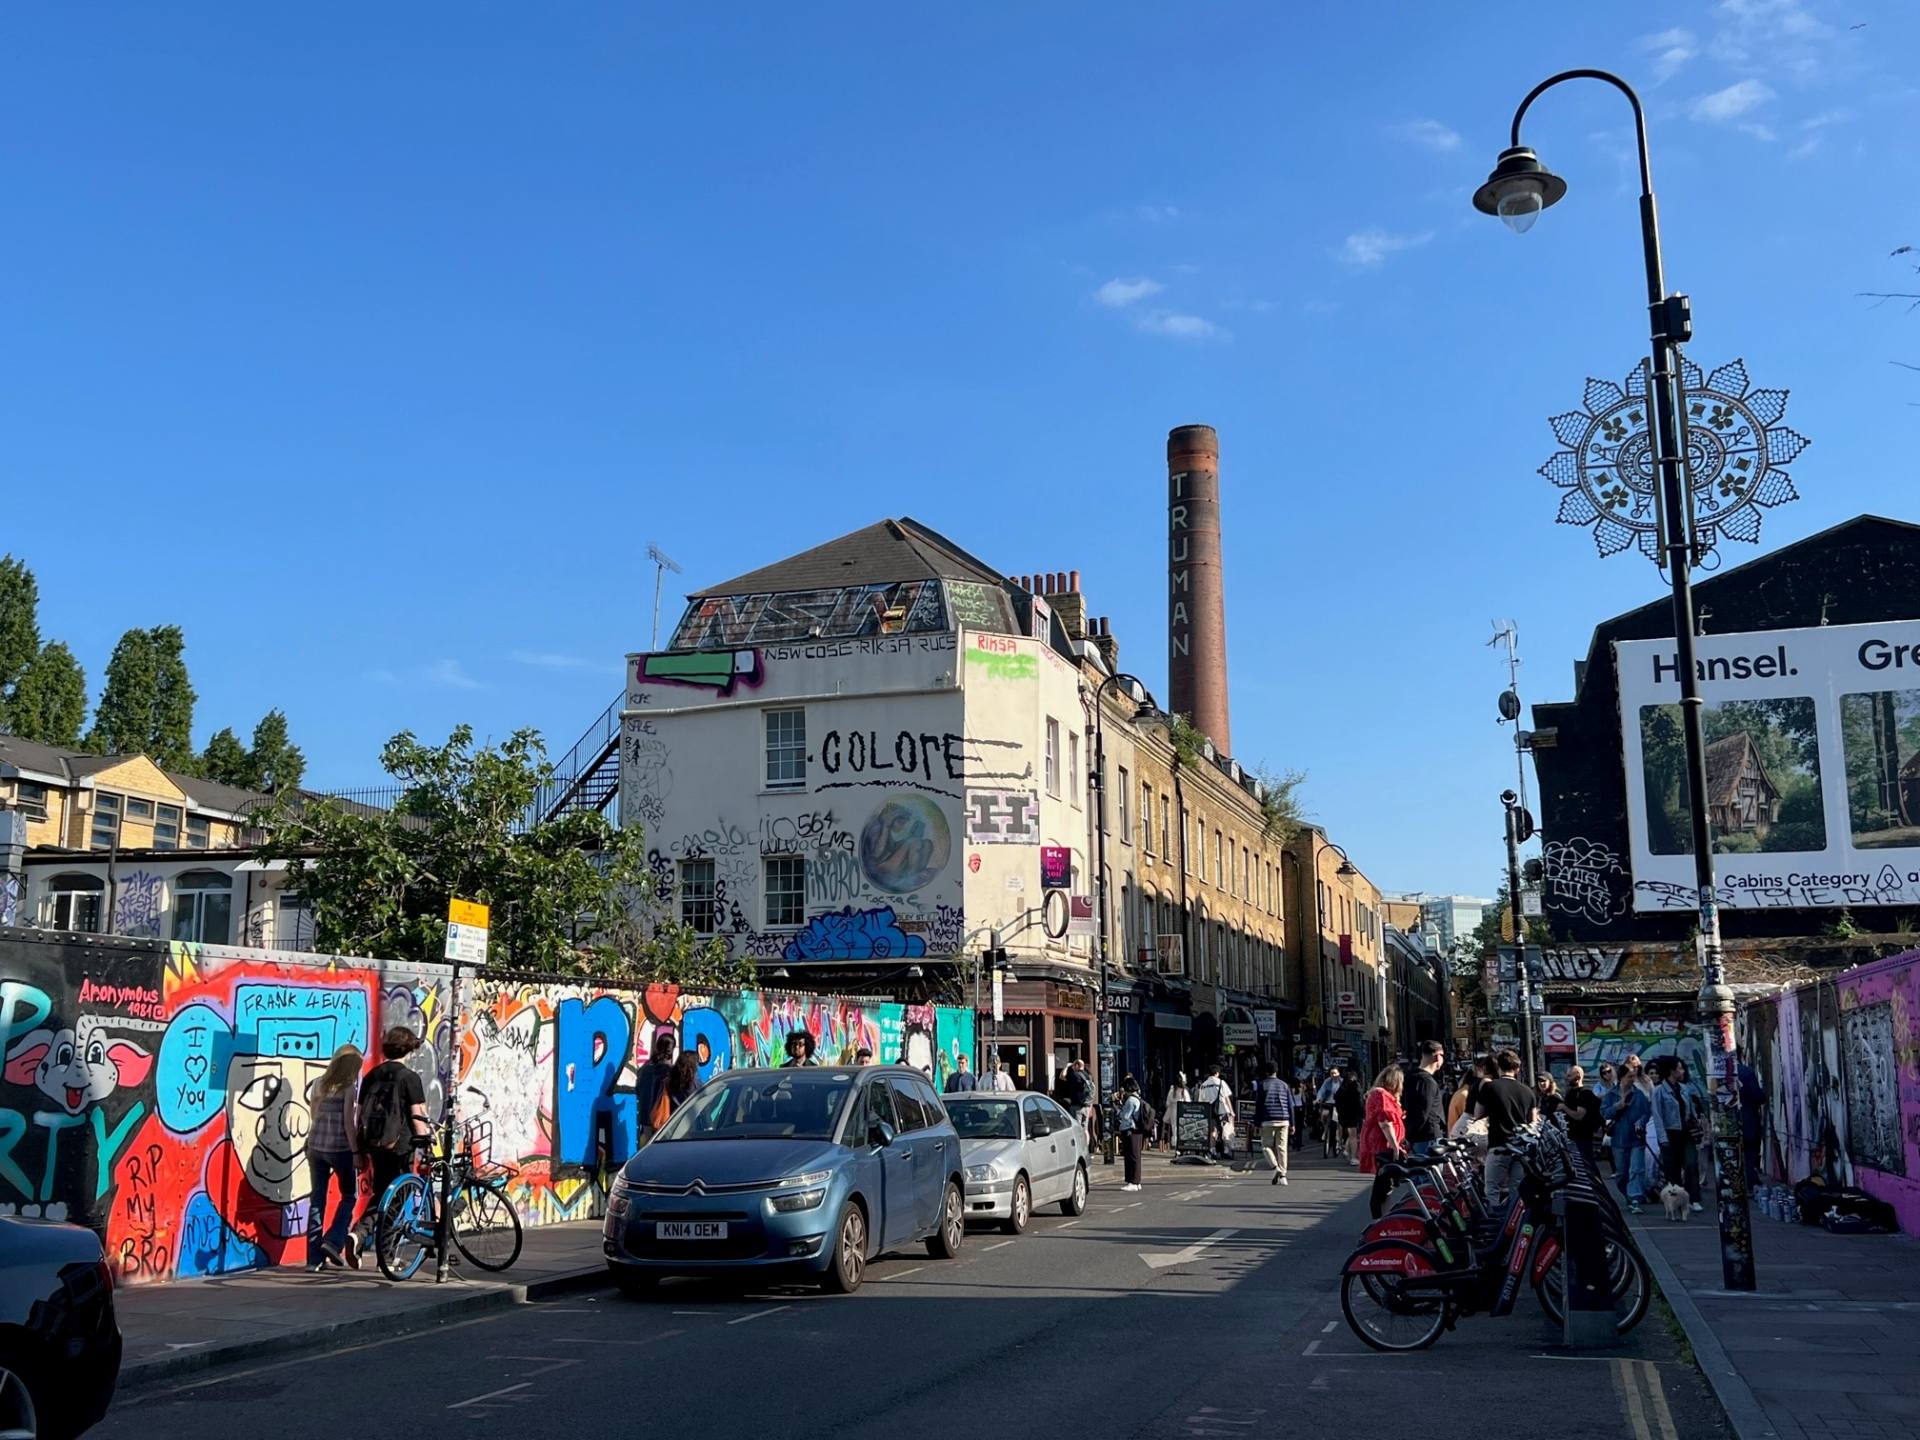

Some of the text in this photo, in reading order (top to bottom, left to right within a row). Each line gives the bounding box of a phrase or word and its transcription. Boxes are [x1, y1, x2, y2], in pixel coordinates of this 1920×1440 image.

[1171, 472, 1189, 658] TRUMAN
[977, 635, 1017, 654] RIKSA
[1724, 872, 1870, 889] Cabins Category
[78, 978, 159, 1009] Anonymous
[1107, 995, 1130, 1008] BAR
[127, 1001, 153, 1018] 1981
[244, 989, 352, 1017] FRANK 4 EVA
[183, 1026, 207, 1048] I
[126, 1143, 164, 1193] RIP
[663, 1223, 720, 1237] KN14 OEM
[1386, 1228, 1421, 1237] Santander
[1369, 1257, 1403, 1266] Santander
